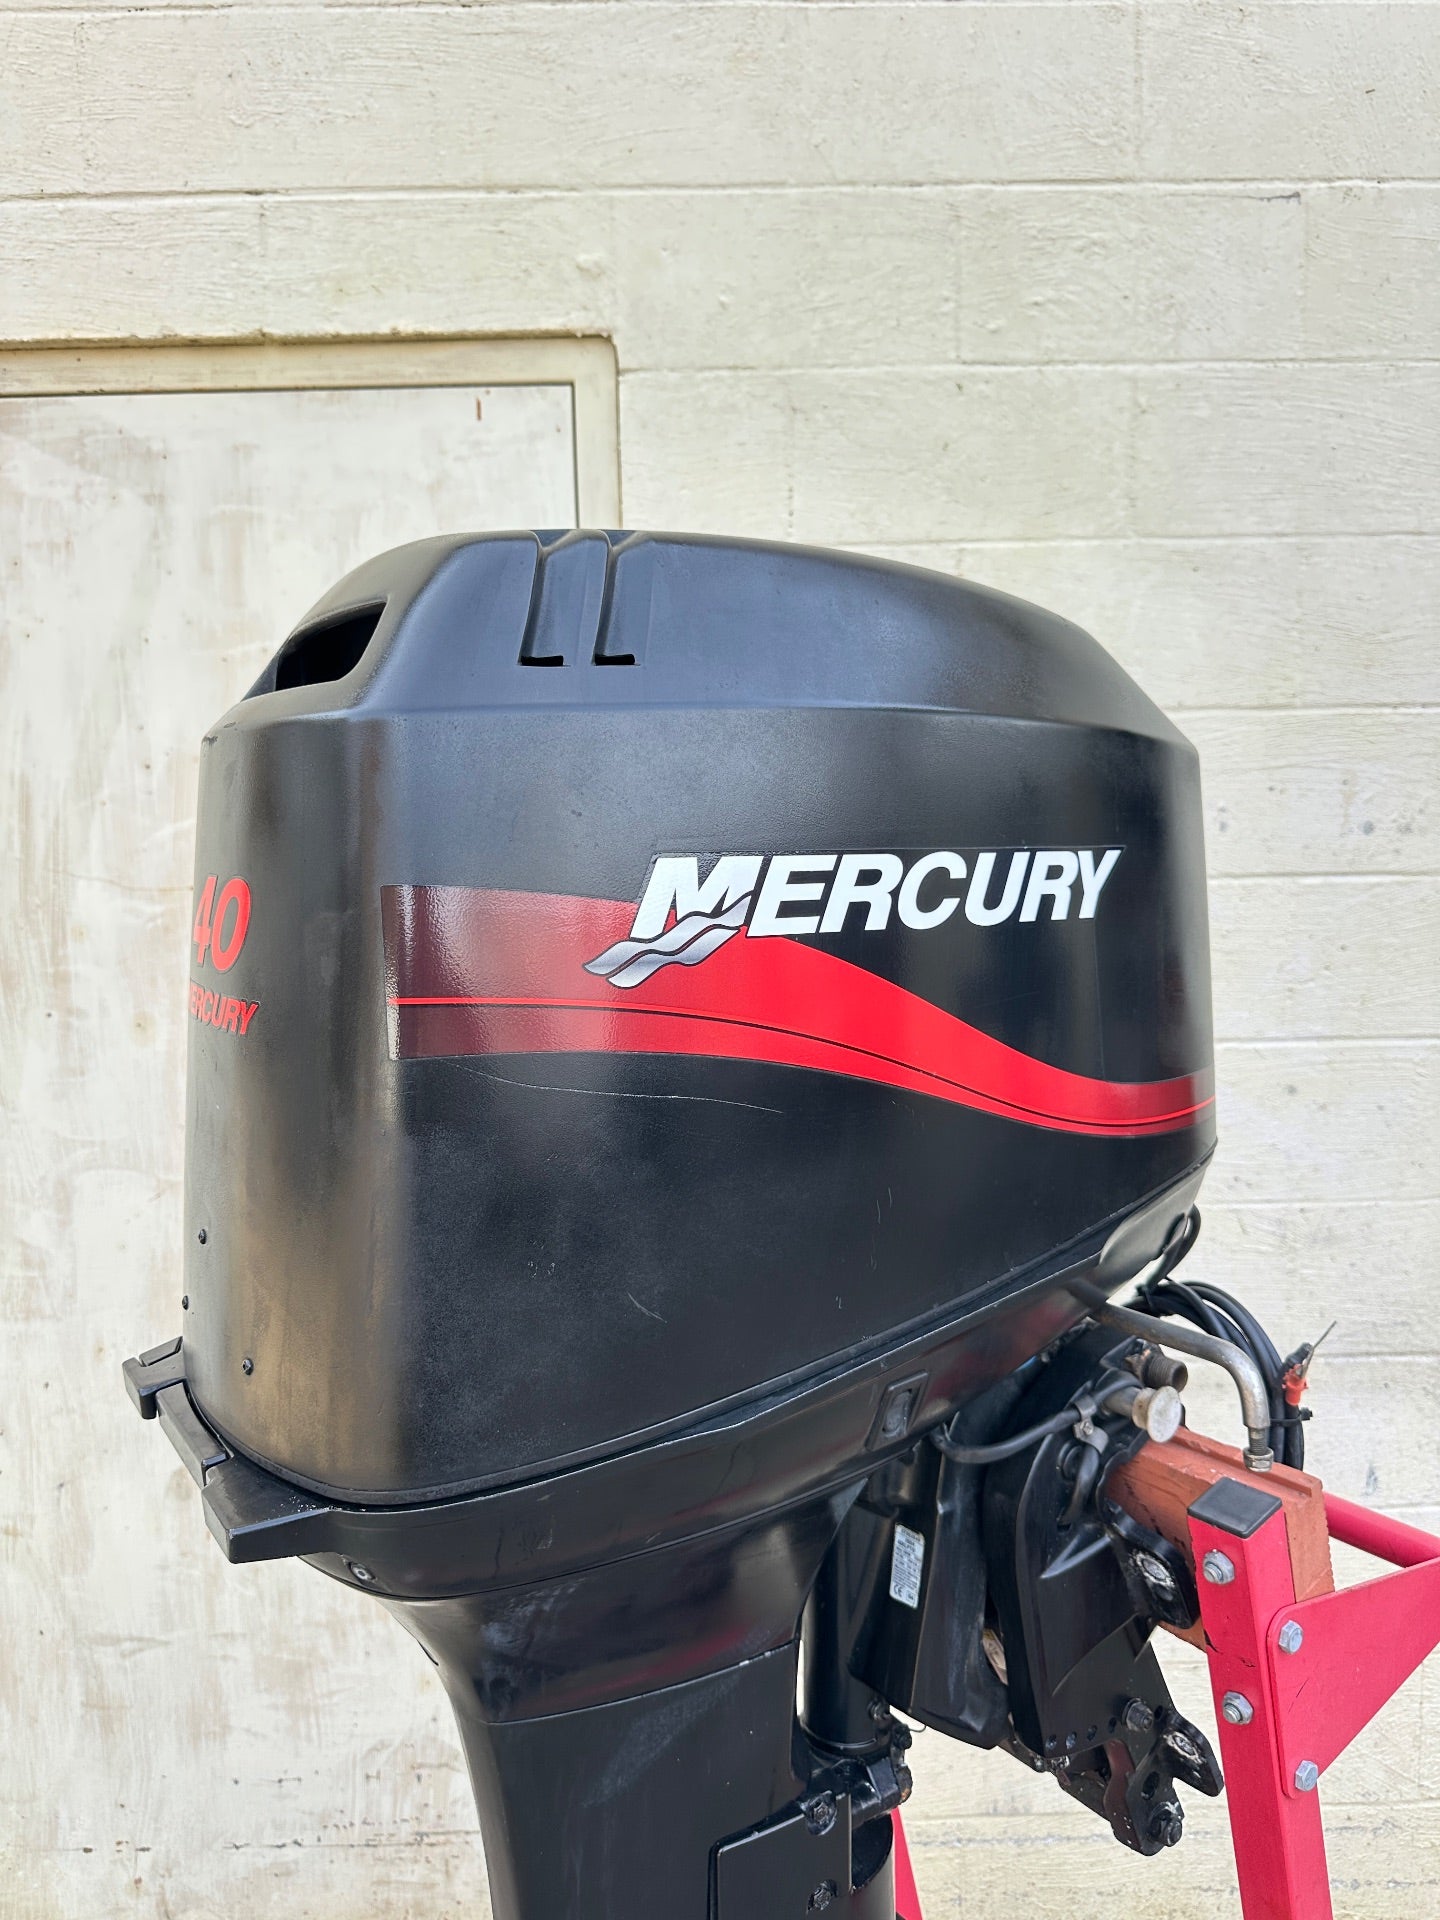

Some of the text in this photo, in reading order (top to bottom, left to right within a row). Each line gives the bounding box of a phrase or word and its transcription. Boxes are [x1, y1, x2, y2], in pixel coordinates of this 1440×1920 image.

[192, 874, 252, 972] 40
[629, 849, 1122, 938] MERCURY
[188, 980, 259, 1036] ERCURY
